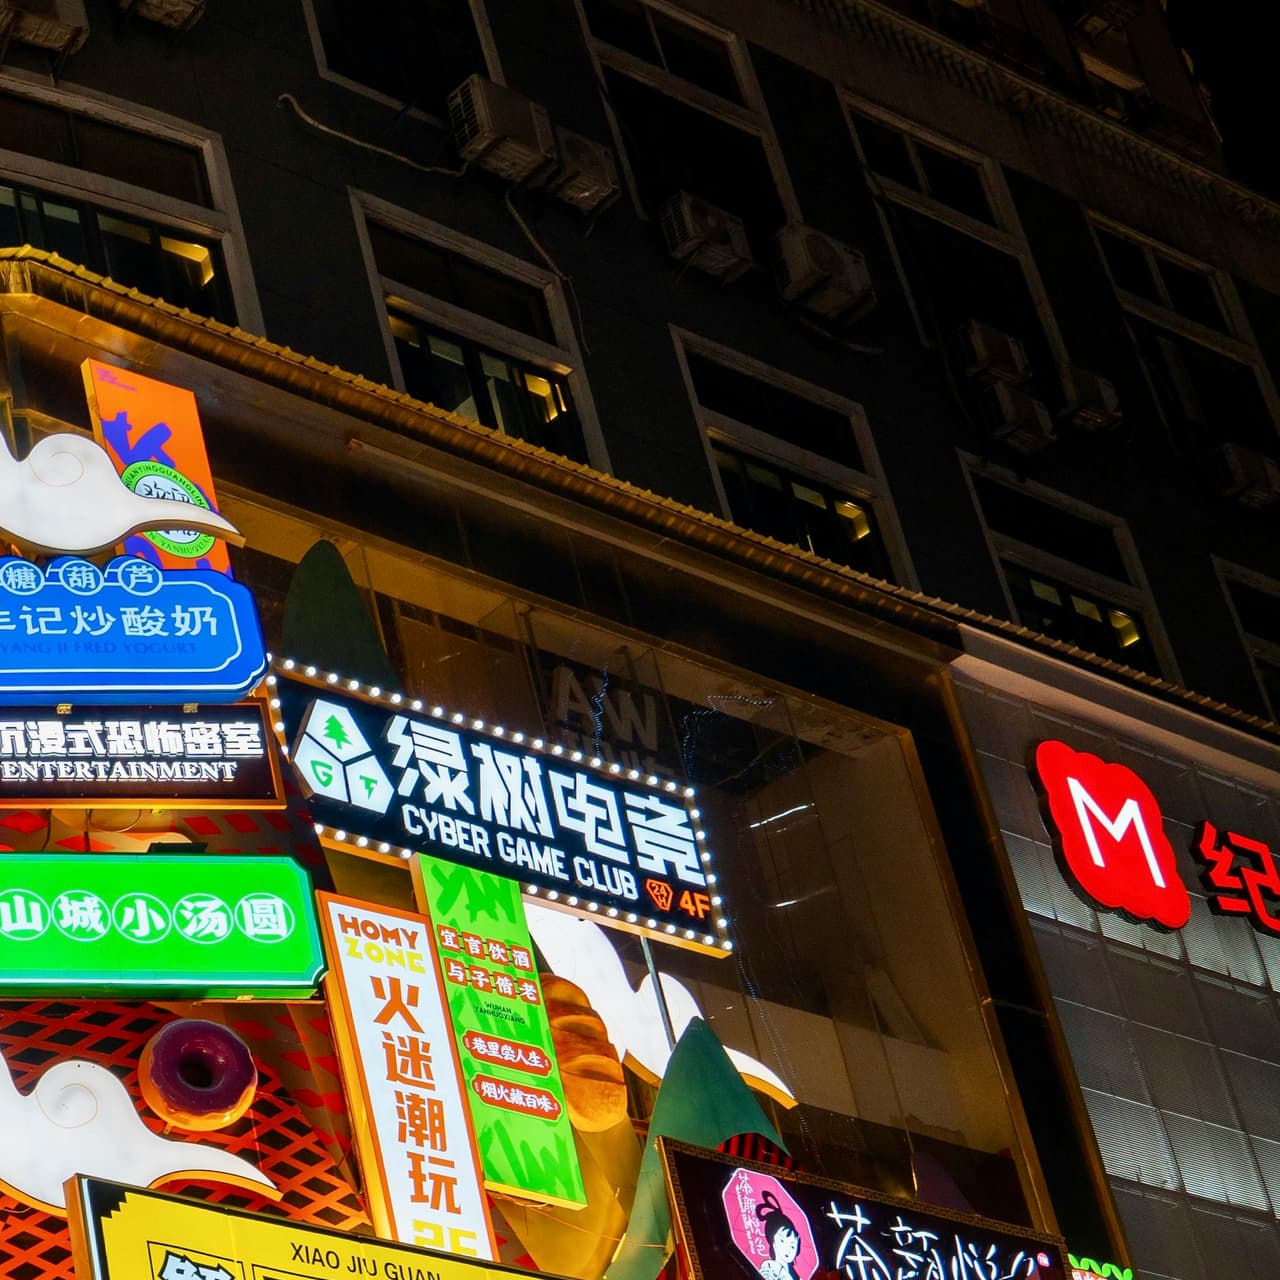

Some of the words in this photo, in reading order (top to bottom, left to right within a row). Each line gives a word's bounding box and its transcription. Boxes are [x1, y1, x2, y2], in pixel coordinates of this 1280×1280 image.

[1, 760, 238, 783] ENTERTAINMENT
[387, 715, 705, 886] 绿树电竞
[1068, 775, 1166, 888] M
[401, 806, 493, 858] CYBER
[497, 832, 570, 881] GAME
[576, 853, 638, 901] CLUB
[680, 890, 710, 919] 4F
[339, 914, 419, 951] HOMY
[346, 938, 426, 974] ZONE
[370, 975, 462, 1215] 火迷潮玩
[291, 1242, 340, 1270] XIAO
[346, 1254, 377, 1276] JIU
